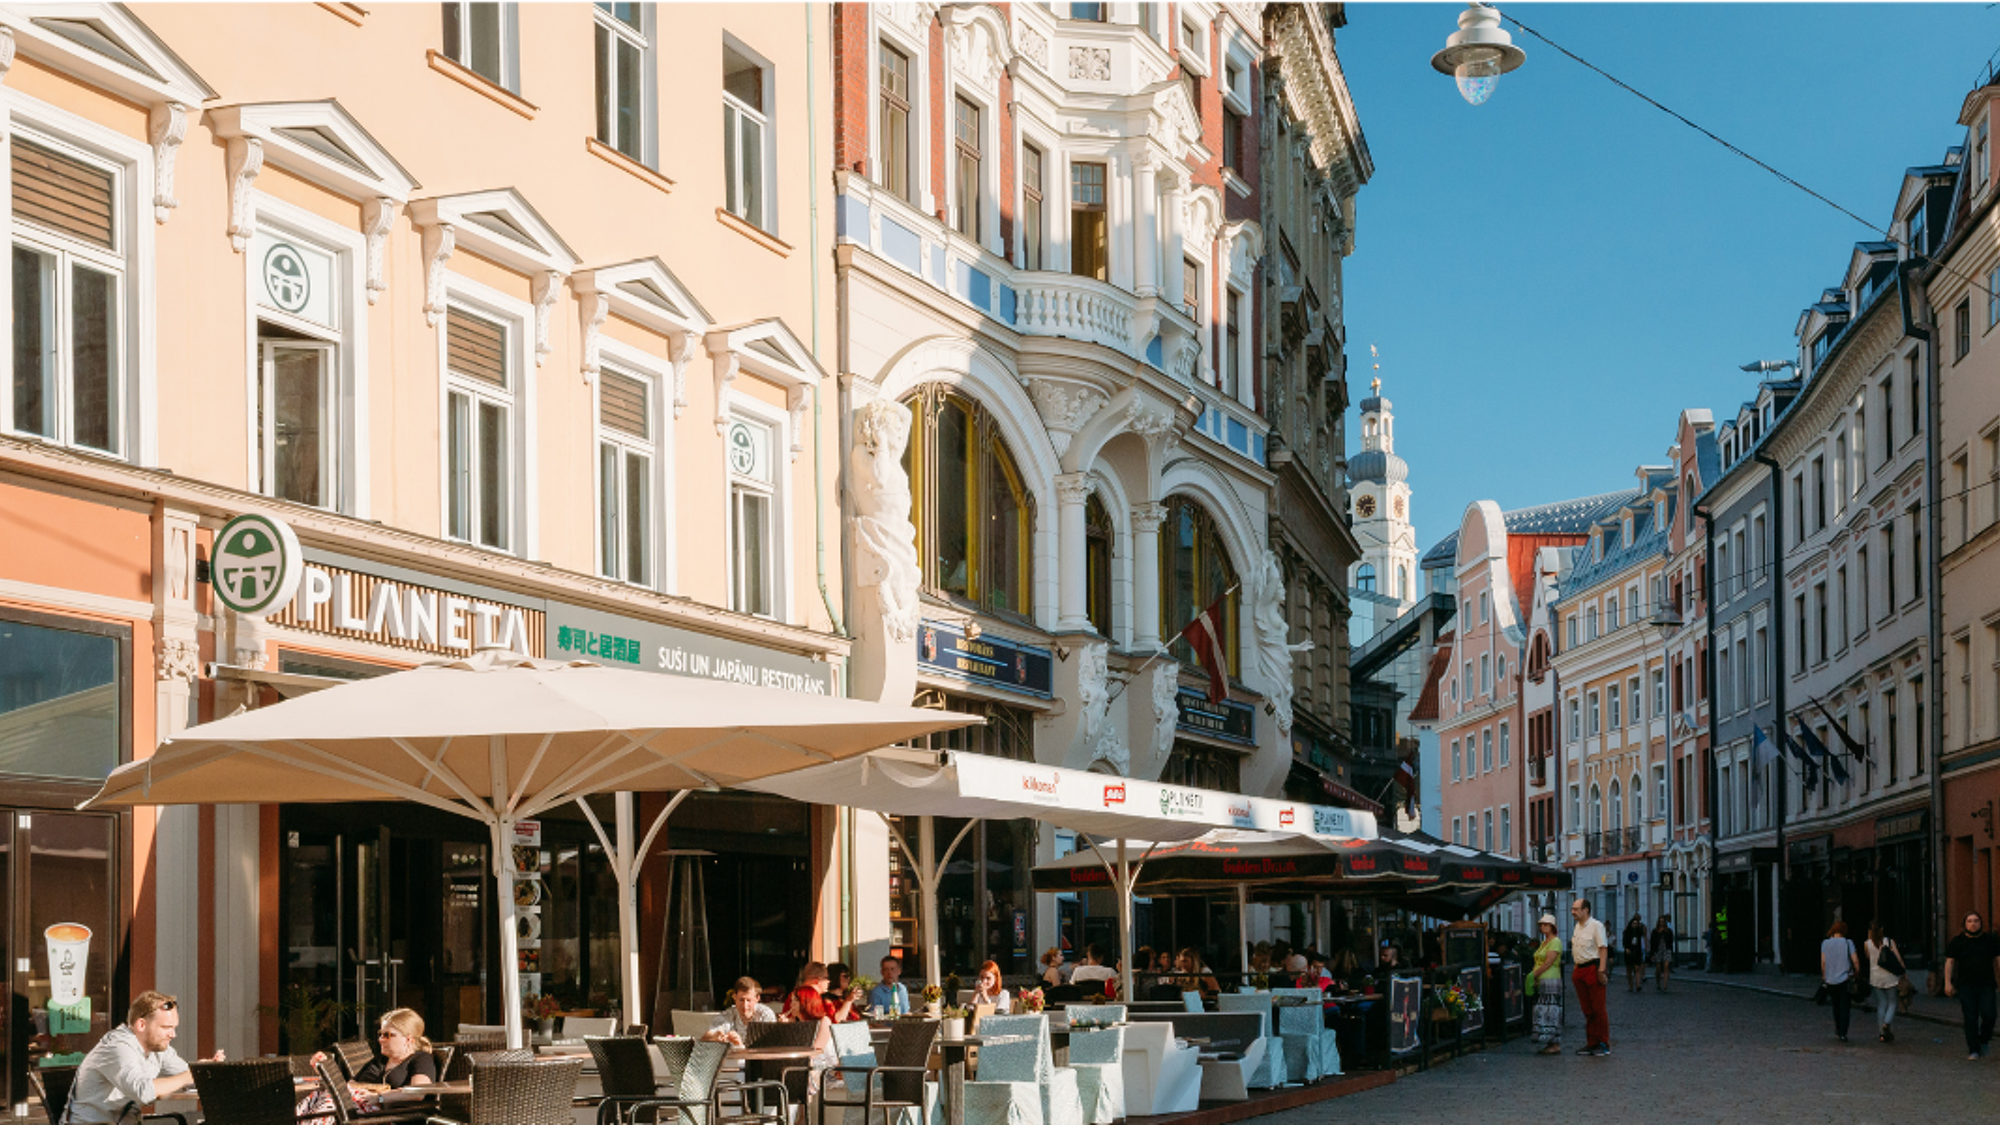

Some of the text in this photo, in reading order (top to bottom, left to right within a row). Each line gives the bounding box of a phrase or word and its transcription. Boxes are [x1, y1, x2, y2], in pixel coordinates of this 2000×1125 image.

[557, 625, 641, 664] 寿司と居酒屋
[658, 646, 687, 672] SUŠI
[690, 653, 710, 676] UN
[761, 667, 825, 696] RESTORĀNS
